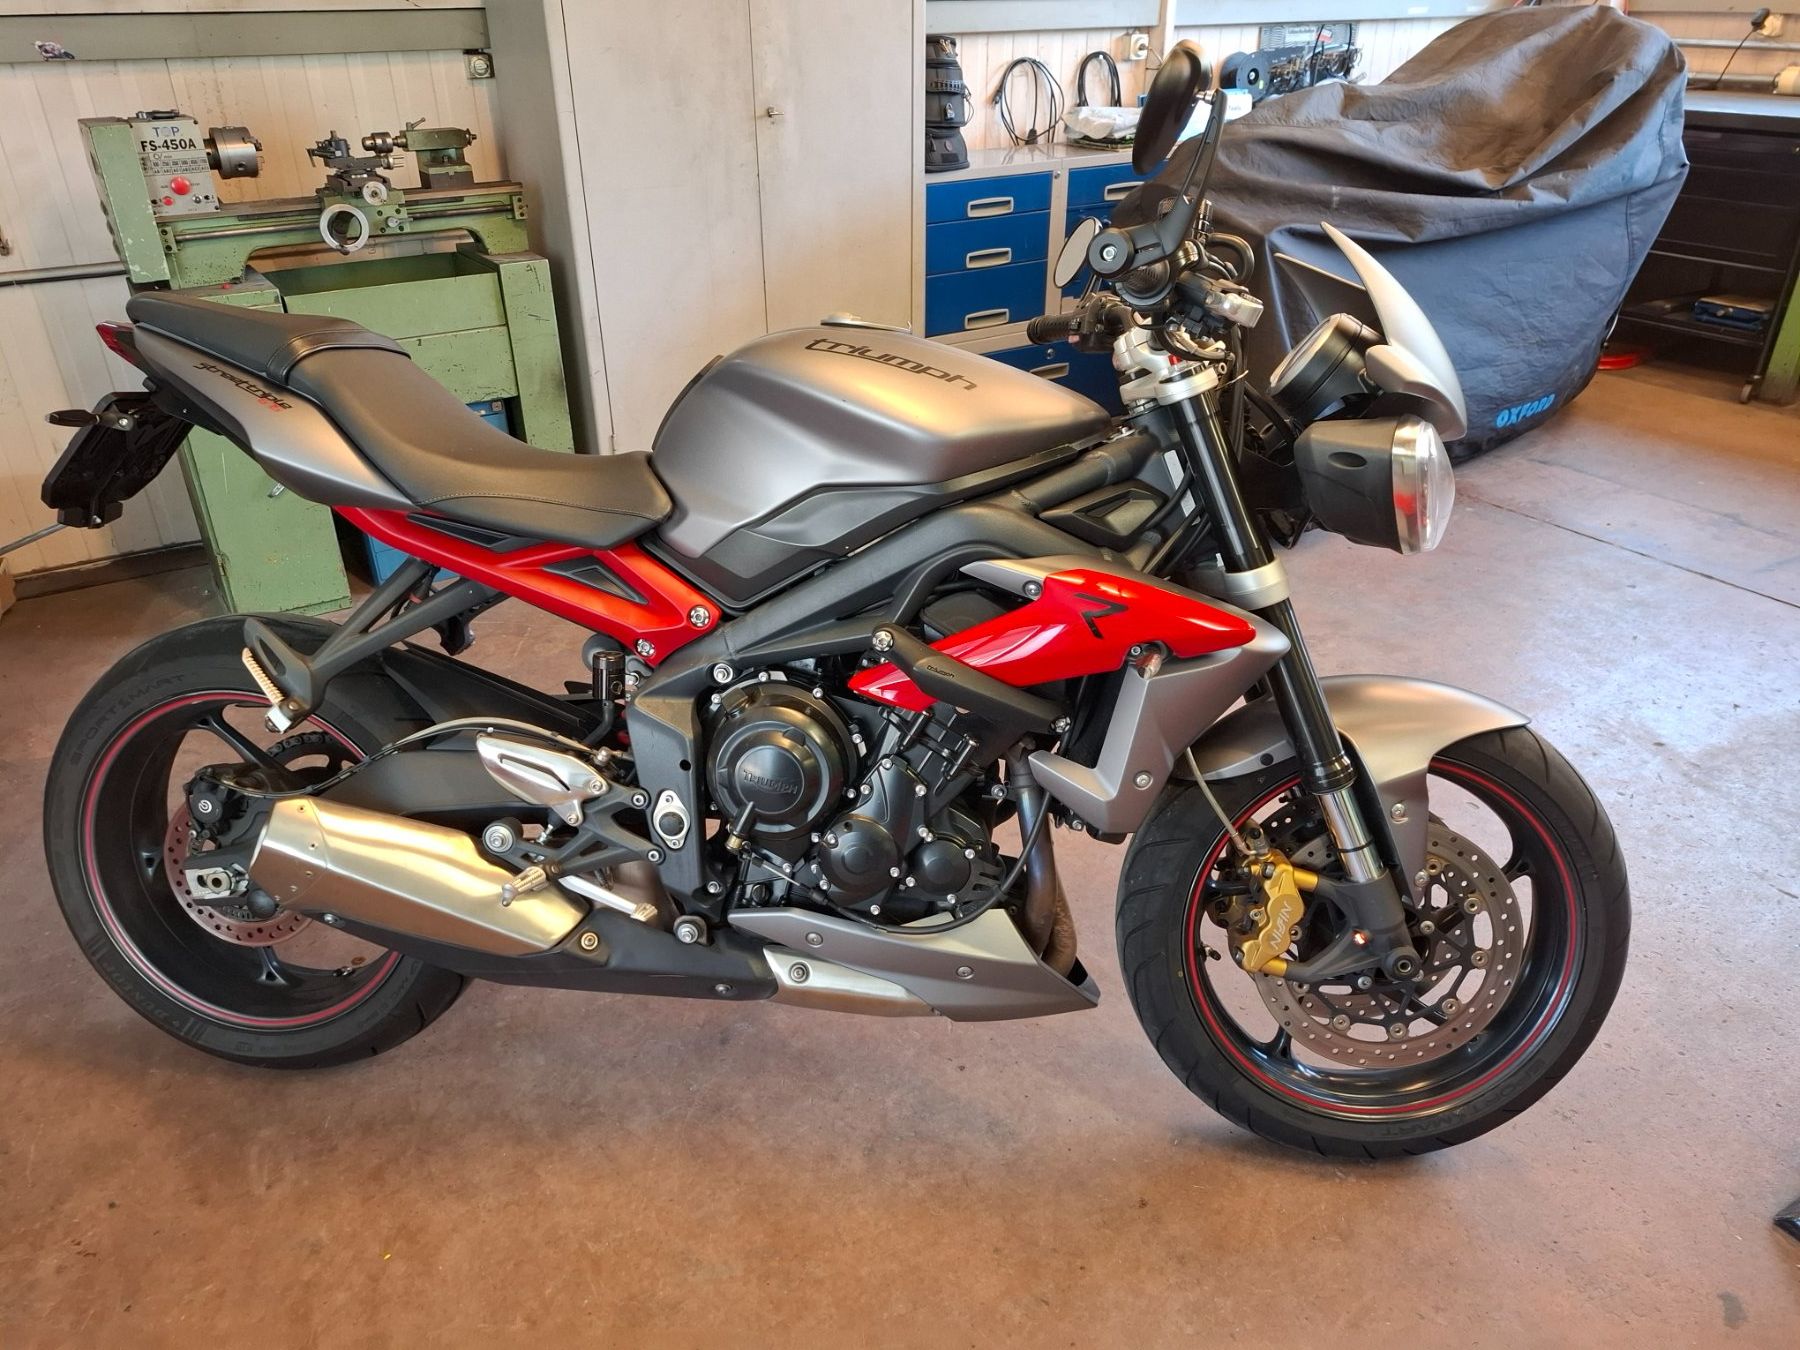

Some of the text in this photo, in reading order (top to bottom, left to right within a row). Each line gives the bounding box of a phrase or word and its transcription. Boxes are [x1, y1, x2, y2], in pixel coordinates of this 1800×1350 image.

[140, 138, 197, 152] FS-450A
[1496, 393, 1556, 428] OXFORD
[743, 769, 798, 795] TRIUMPH
